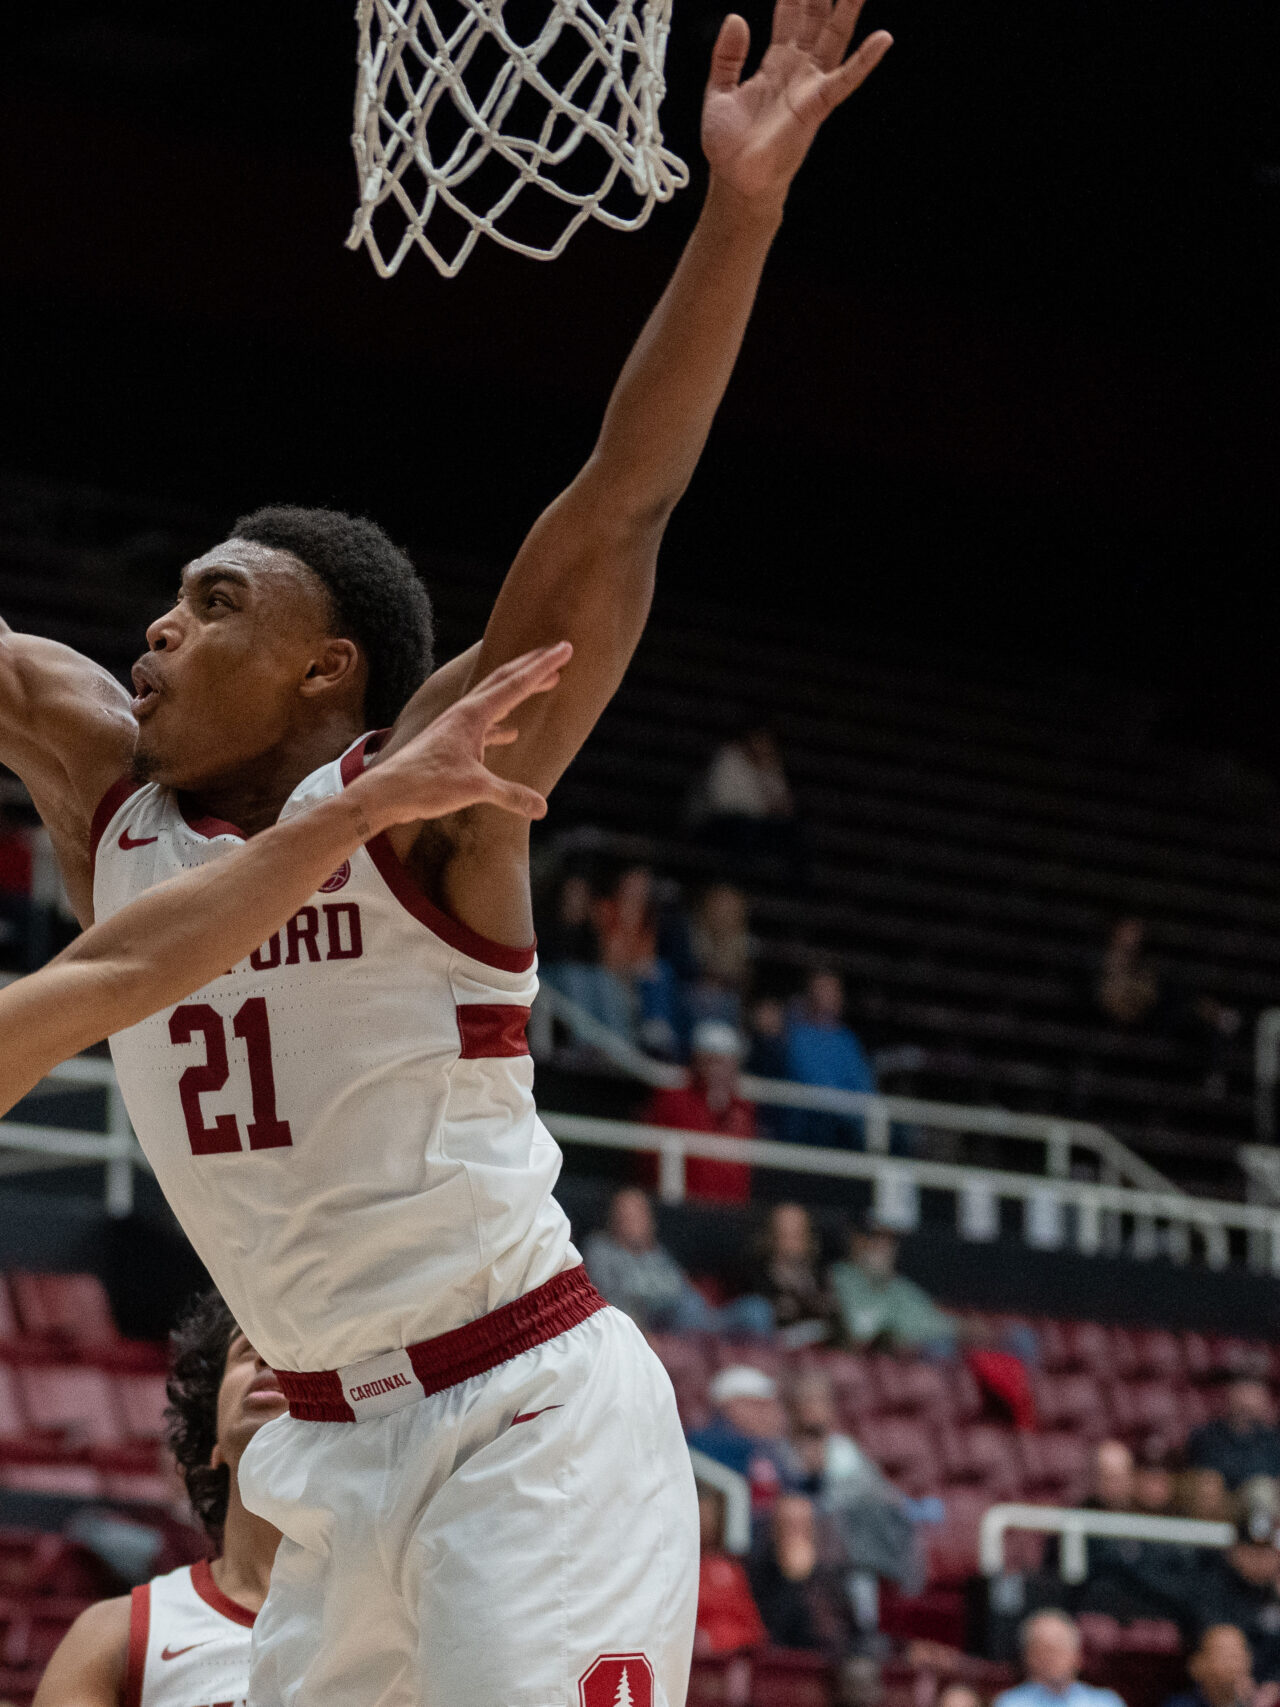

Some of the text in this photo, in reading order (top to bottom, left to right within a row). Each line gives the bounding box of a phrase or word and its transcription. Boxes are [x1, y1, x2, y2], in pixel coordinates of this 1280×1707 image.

[223, 902, 363, 974] ORD
[168, 997, 293, 1156] 21
[349, 1373, 411, 1402] CARDINAL
